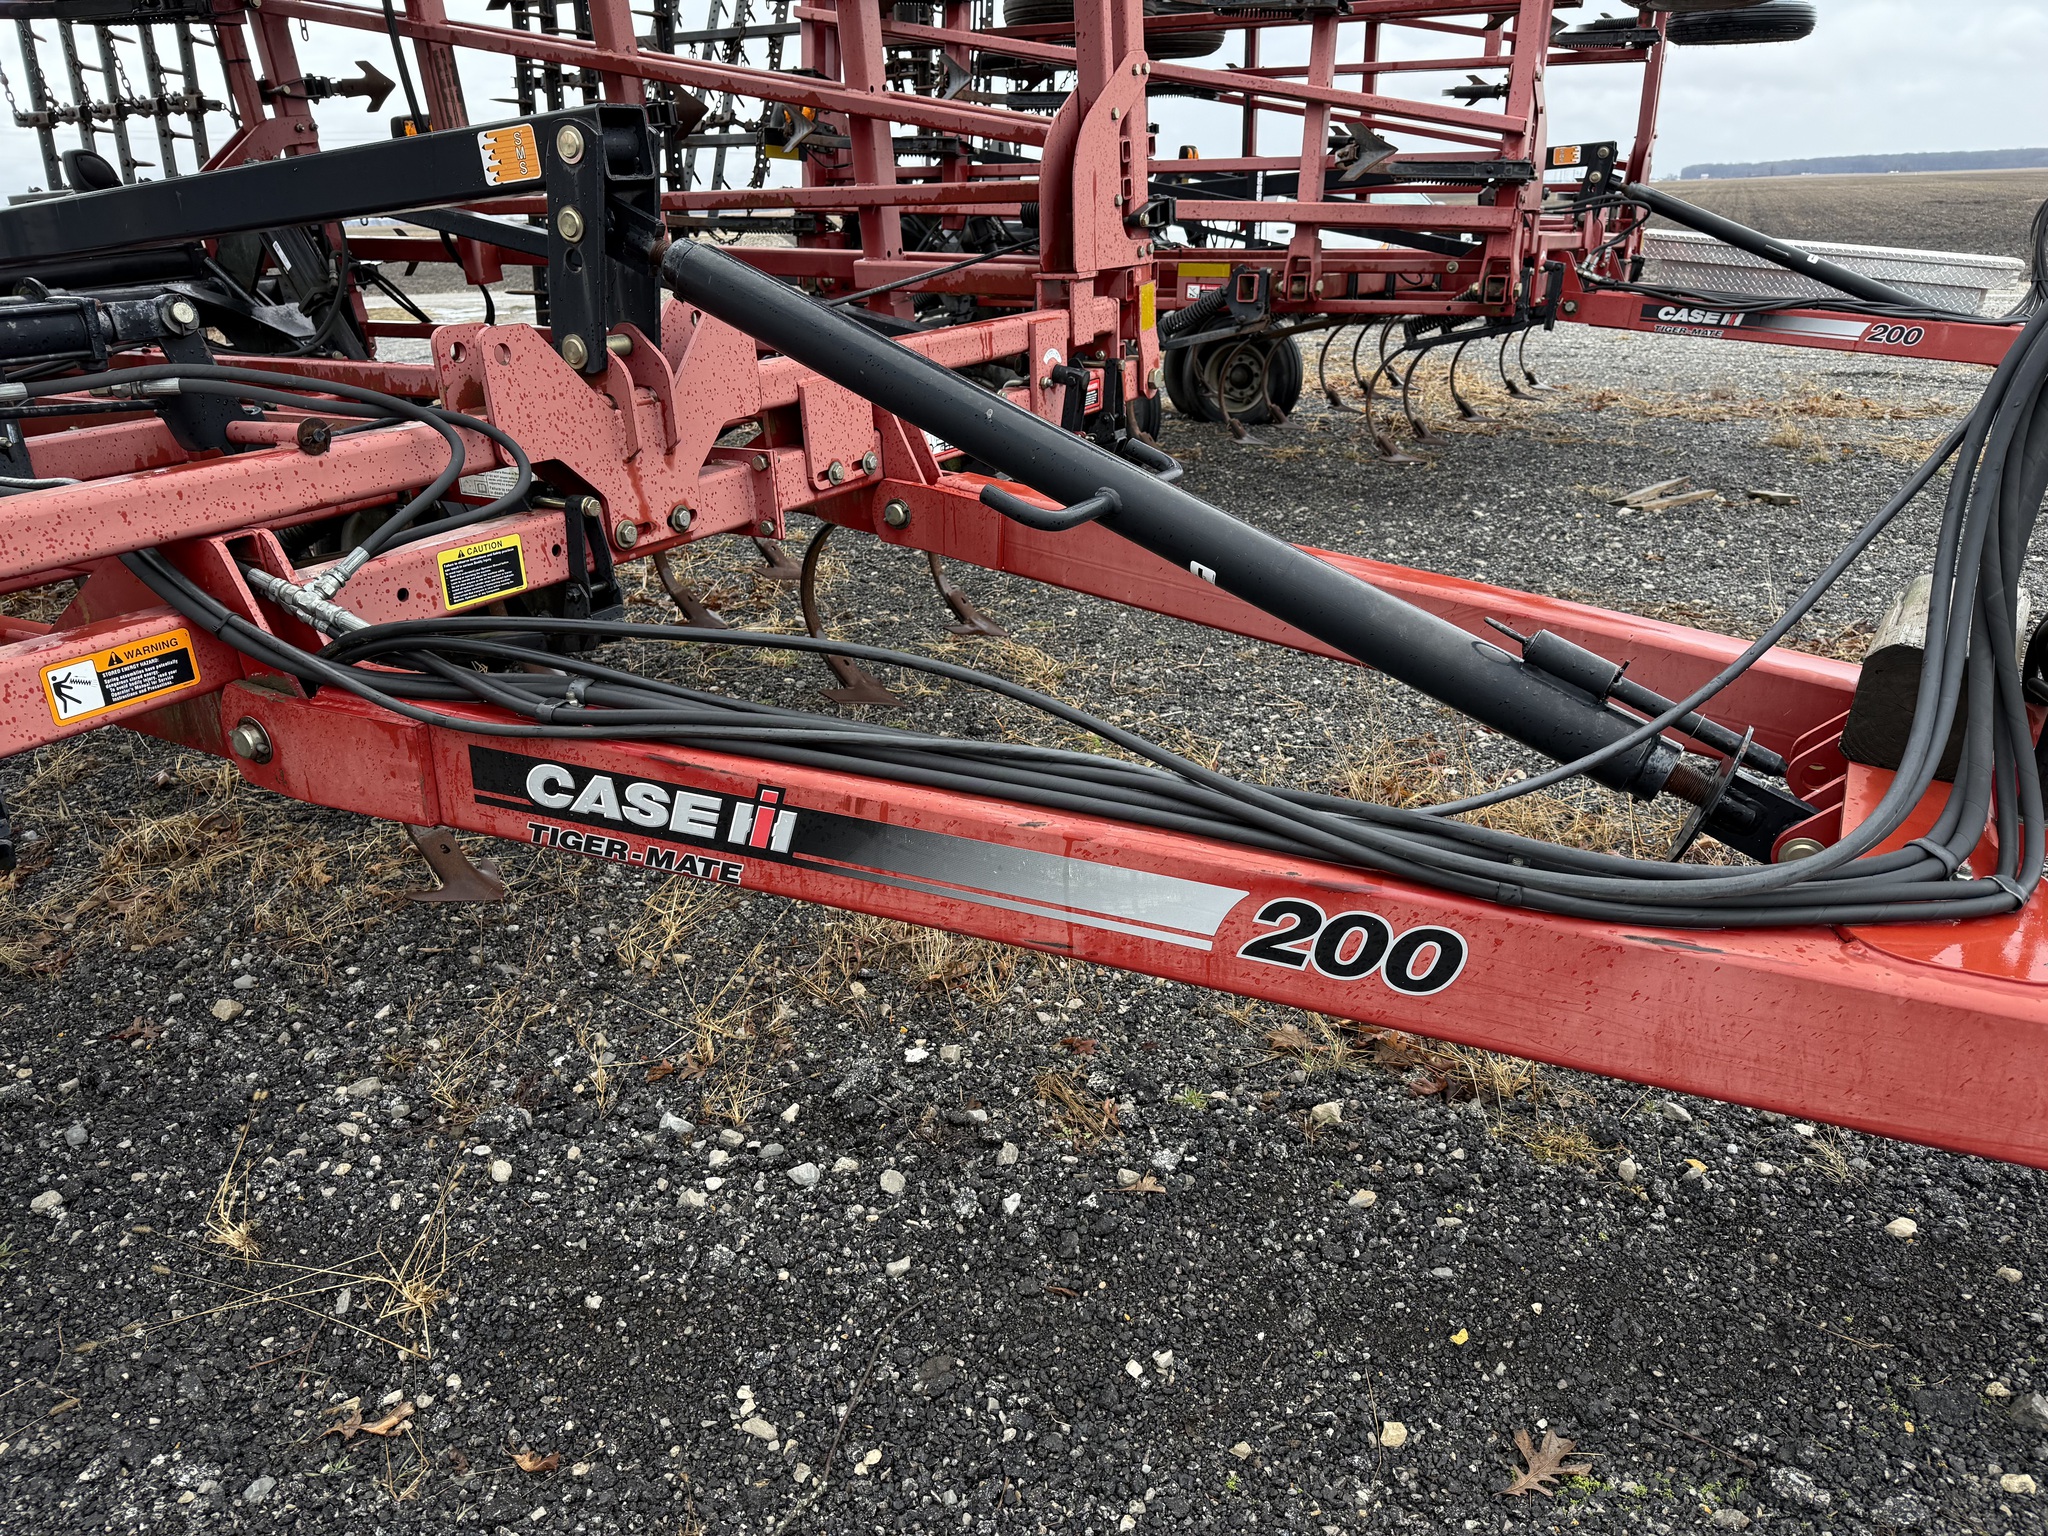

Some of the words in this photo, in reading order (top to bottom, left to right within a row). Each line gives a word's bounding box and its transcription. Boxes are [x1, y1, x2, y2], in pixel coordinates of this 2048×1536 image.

[1657, 306, 1721, 325] CASE
[1864, 323, 1925, 347] 200
[467, 540, 502, 555] CAUTION
[124, 638, 178, 660] WARNING
[102, 669, 120, 678] STORED
[121, 663, 139, 672] ENERGY
[525, 763, 723, 838] CASE
[527, 821, 744, 884] TIGER-MATE
[1236, 897, 1468, 996] 200
